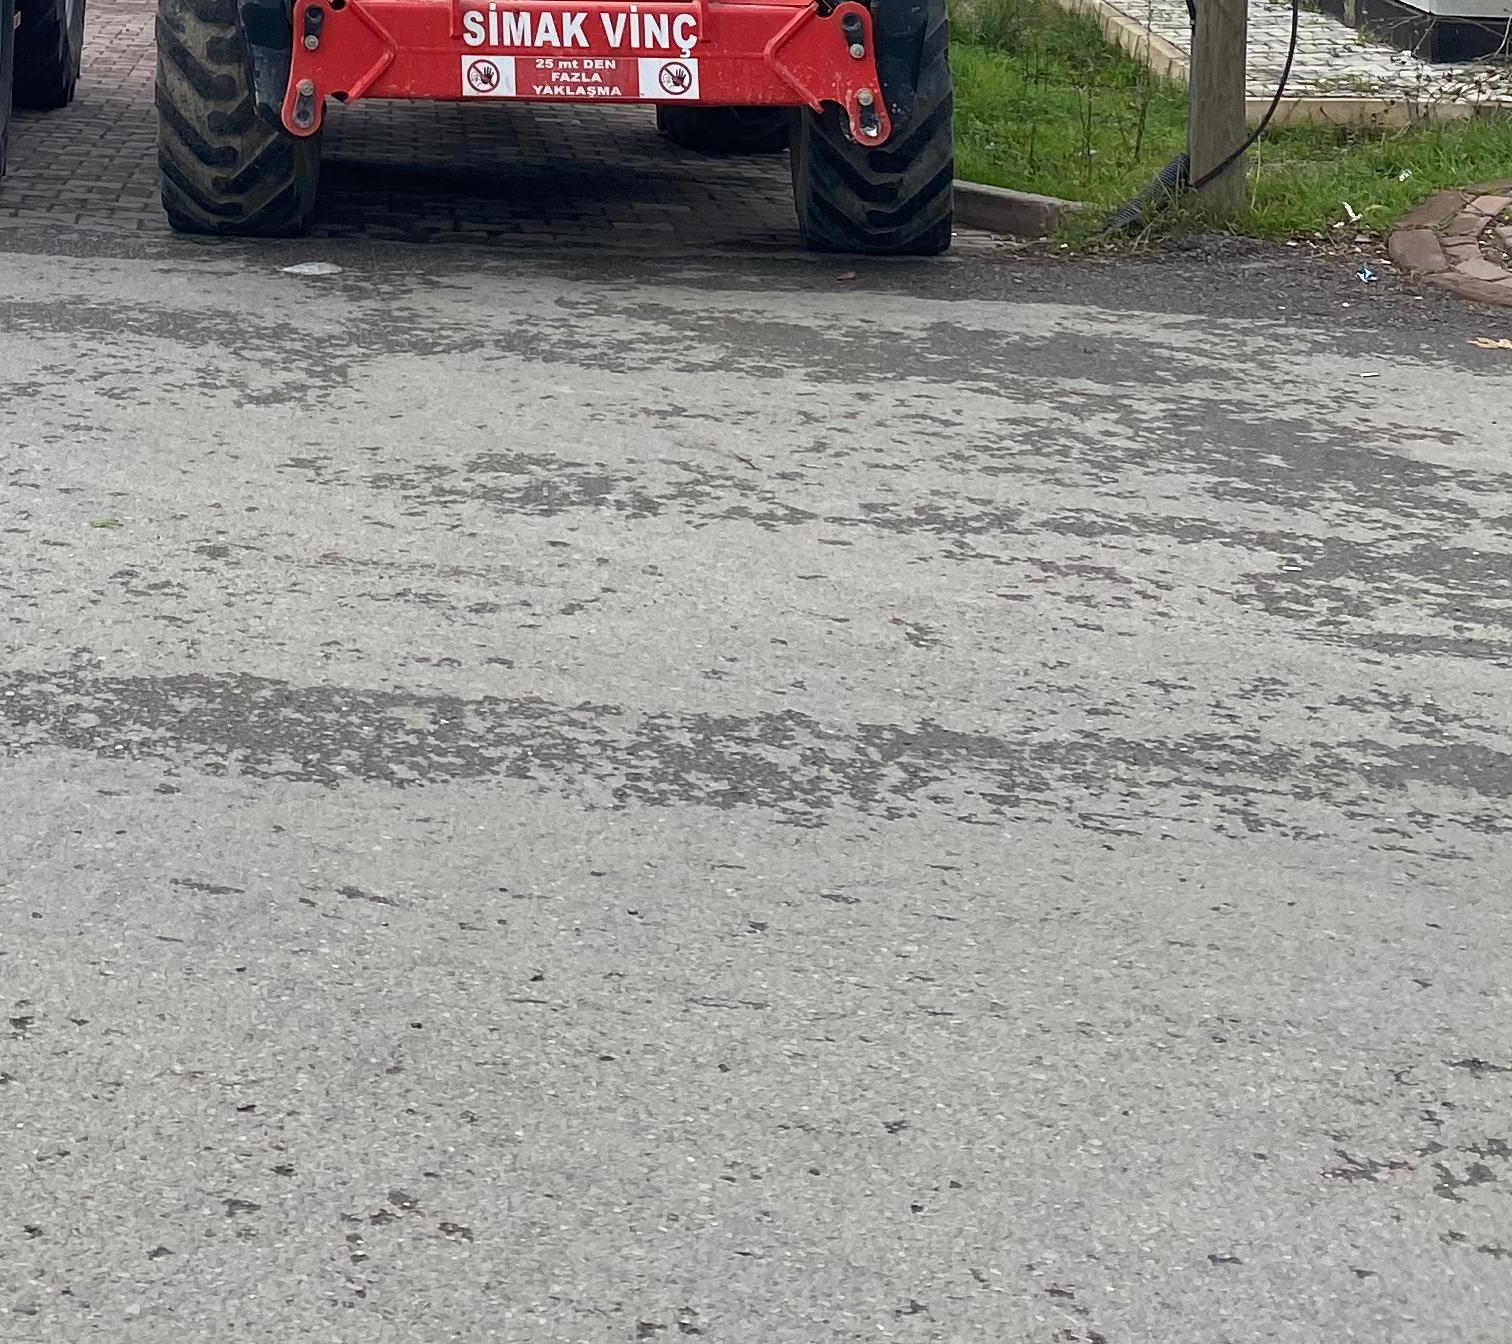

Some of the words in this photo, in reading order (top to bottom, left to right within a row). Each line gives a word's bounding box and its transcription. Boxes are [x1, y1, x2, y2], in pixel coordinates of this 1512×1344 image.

[462, 2, 590, 48] SİMAK
[599, 3, 698, 59] VİNÇ
[535, 58, 558, 70] 25
[558, 58, 579, 70] mt
[583, 58, 617, 70] DEN
[551, 72, 603, 83] FAZLA
[532, 84, 622, 98] YAKLAŞMA
